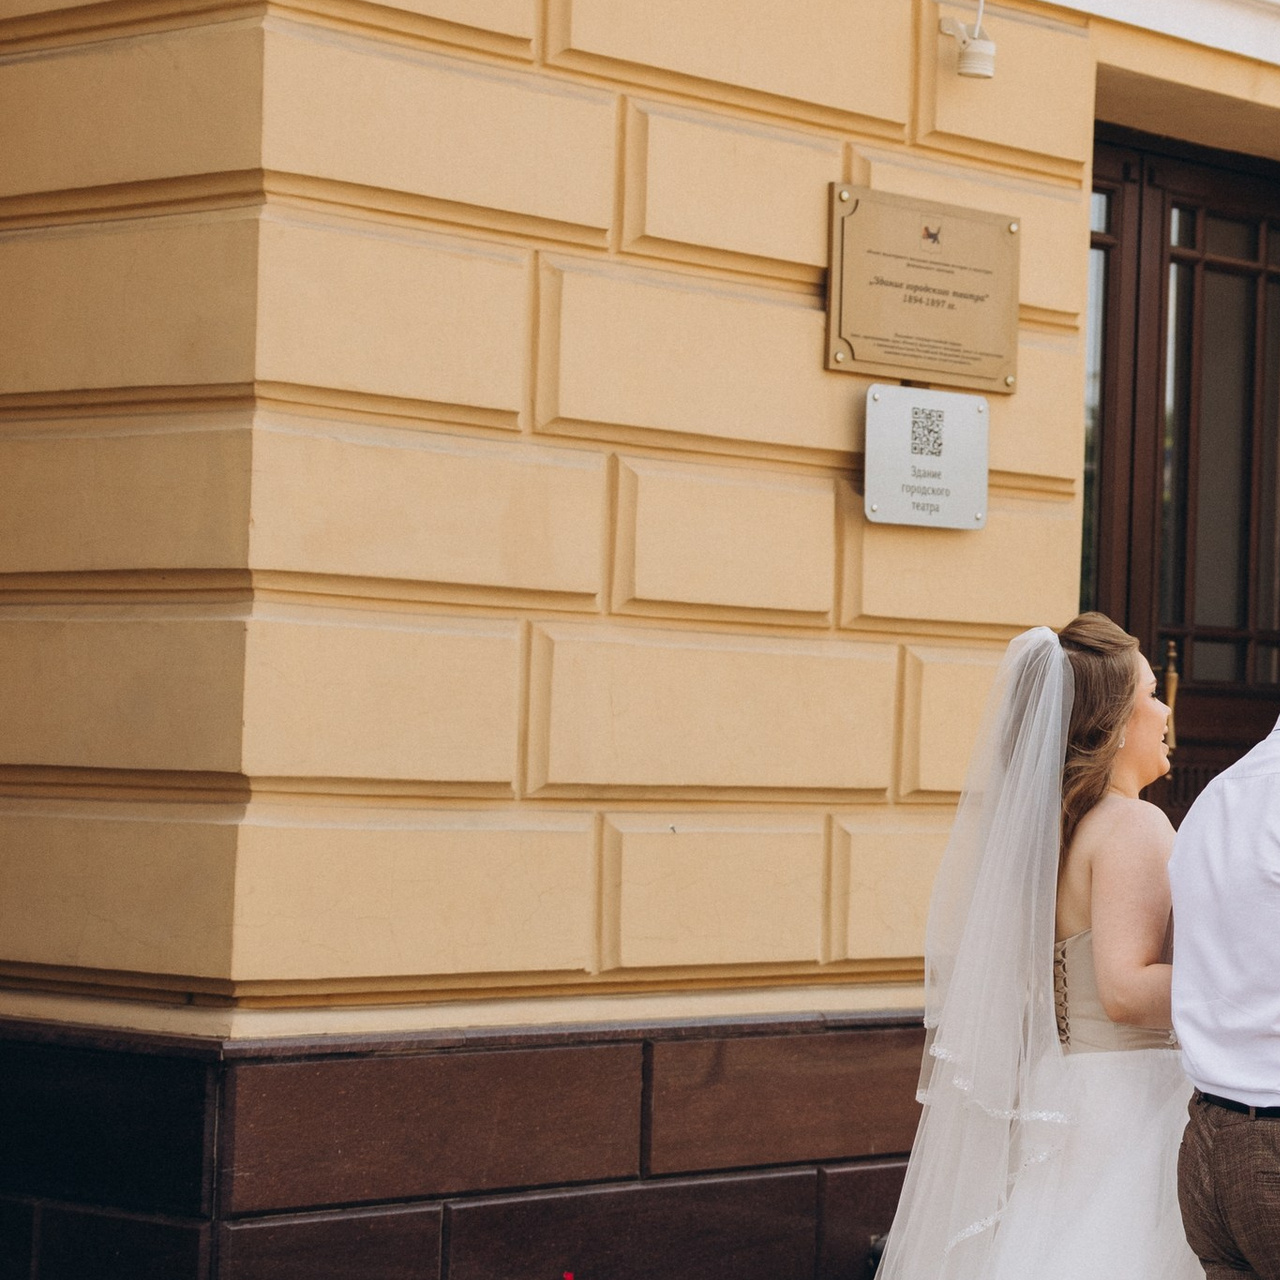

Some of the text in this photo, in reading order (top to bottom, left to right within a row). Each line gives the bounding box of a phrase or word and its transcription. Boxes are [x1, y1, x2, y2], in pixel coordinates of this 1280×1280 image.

[912, 465, 941, 479] Здание
[902, 483, 950, 496] городского
[912, 501, 940, 514] театра
